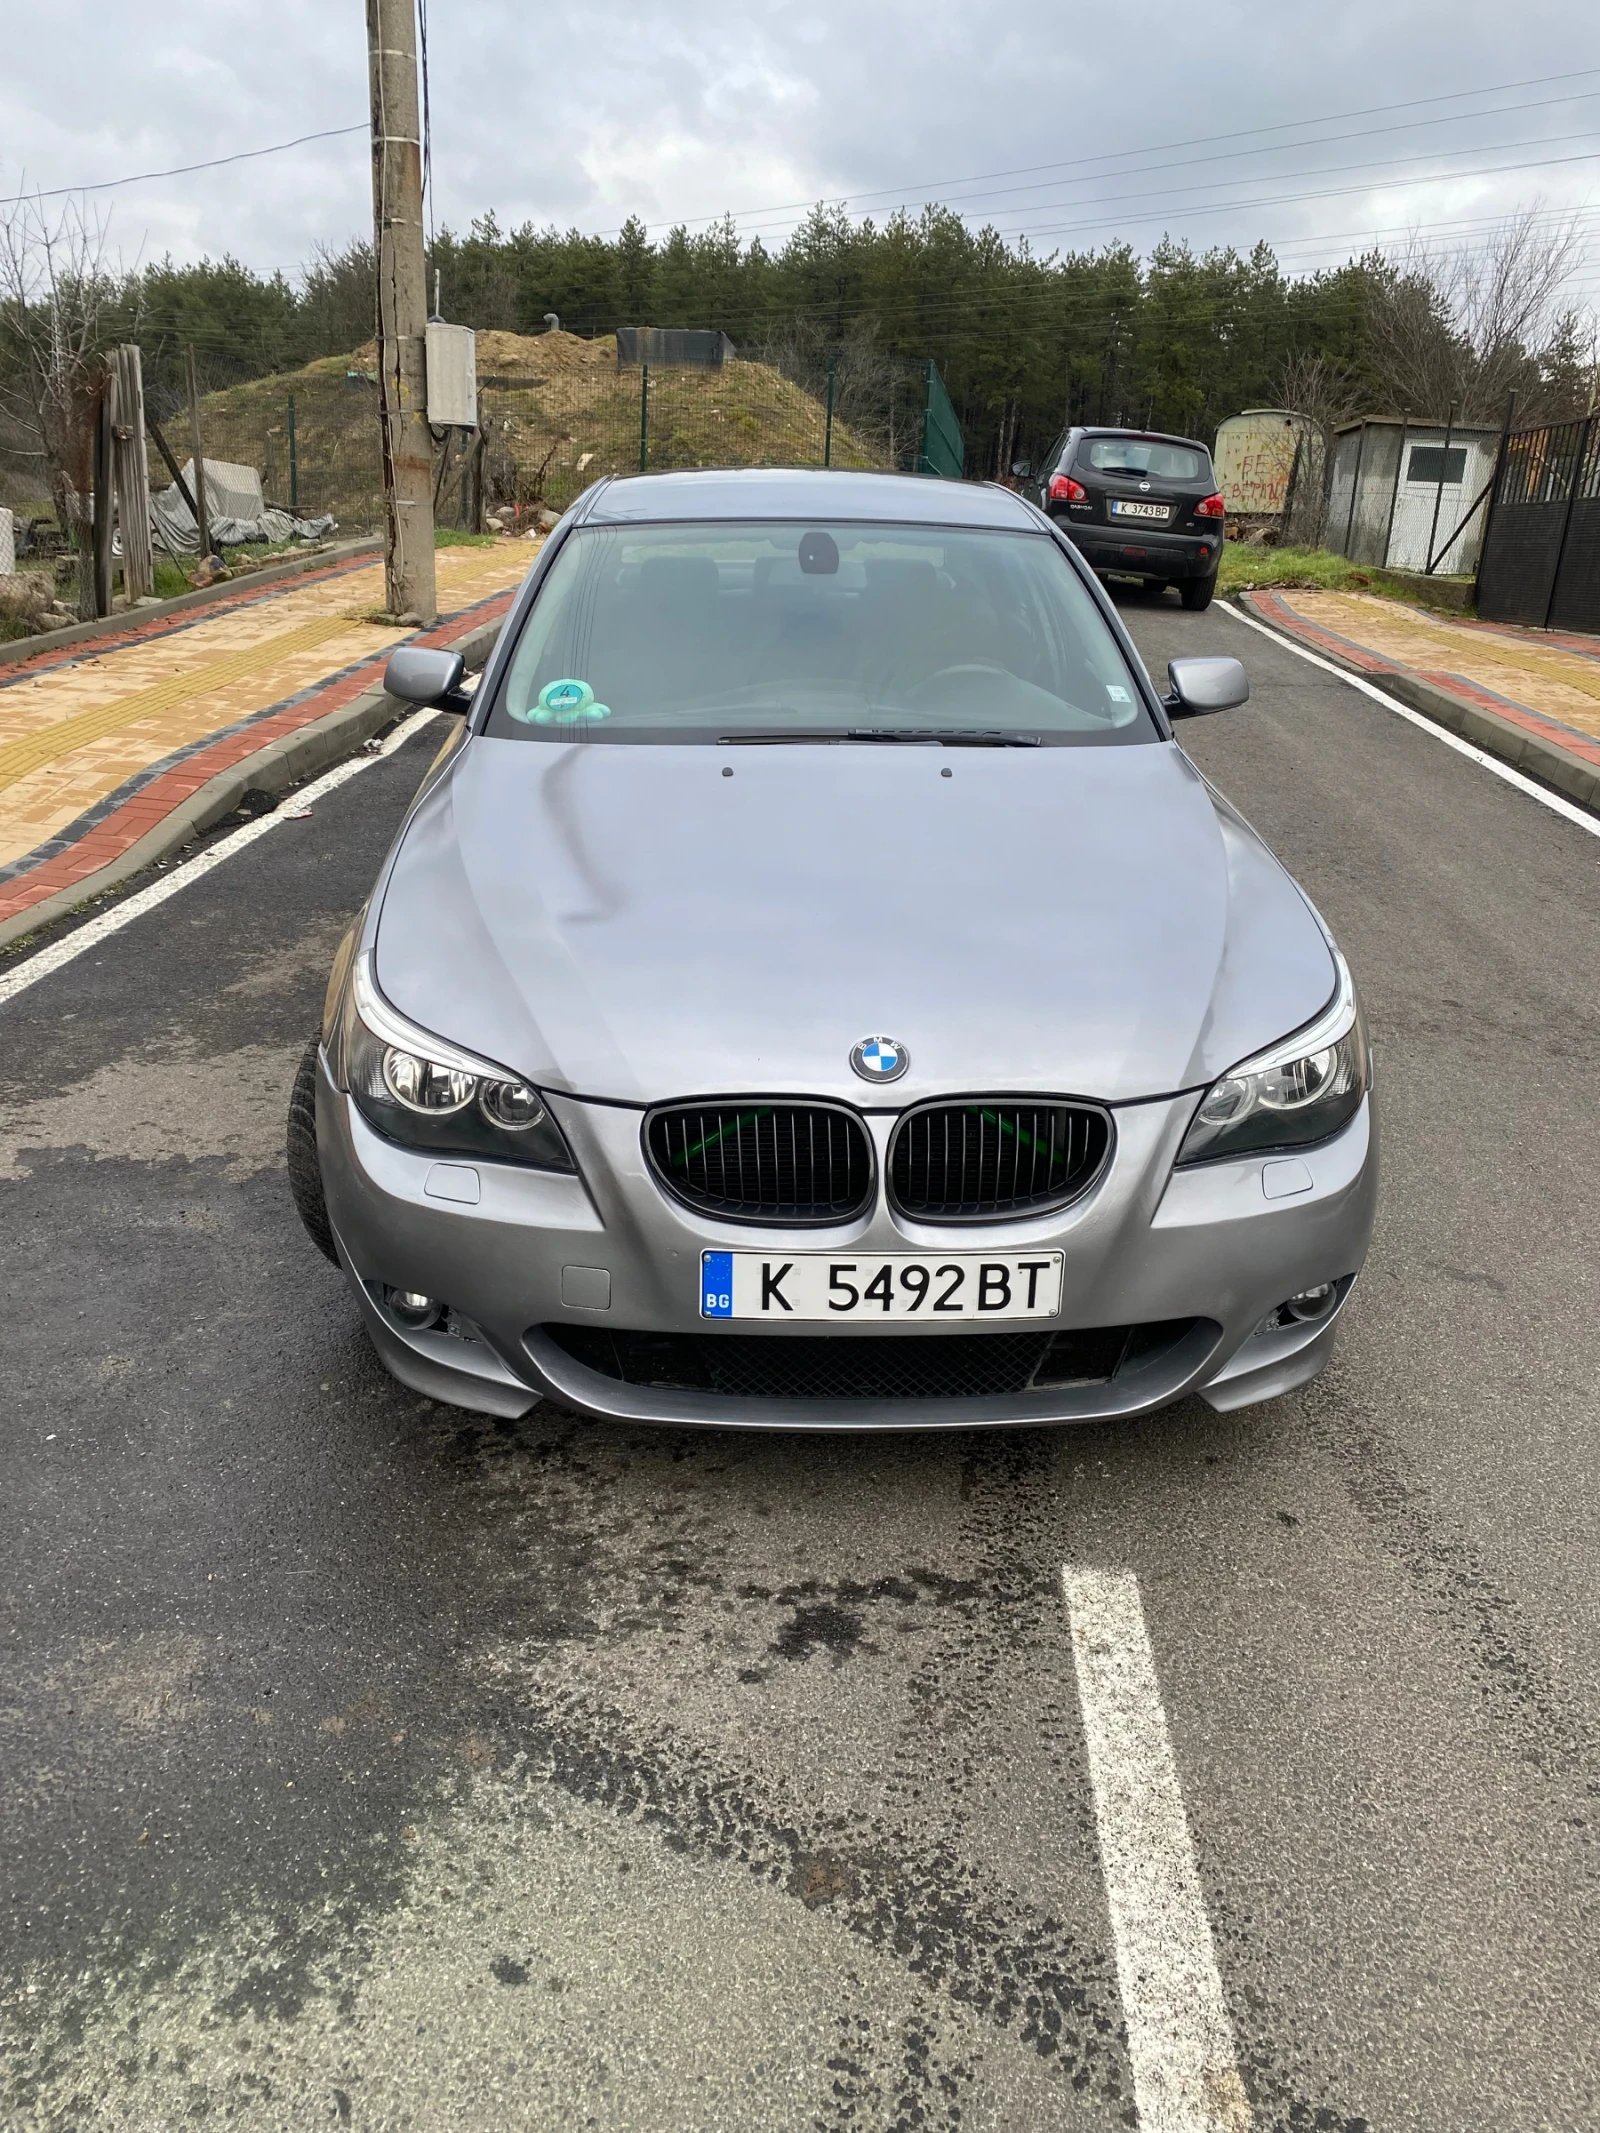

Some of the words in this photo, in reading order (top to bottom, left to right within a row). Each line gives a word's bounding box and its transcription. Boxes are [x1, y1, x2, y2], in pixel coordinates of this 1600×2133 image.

[1121, 503, 1128, 514] K
[857, 1036, 901, 1050] BMW
[761, 1262, 794, 1312] K
[828, 1261, 1051, 1312] 5492BT
[706, 1293, 730, 1309] BG
